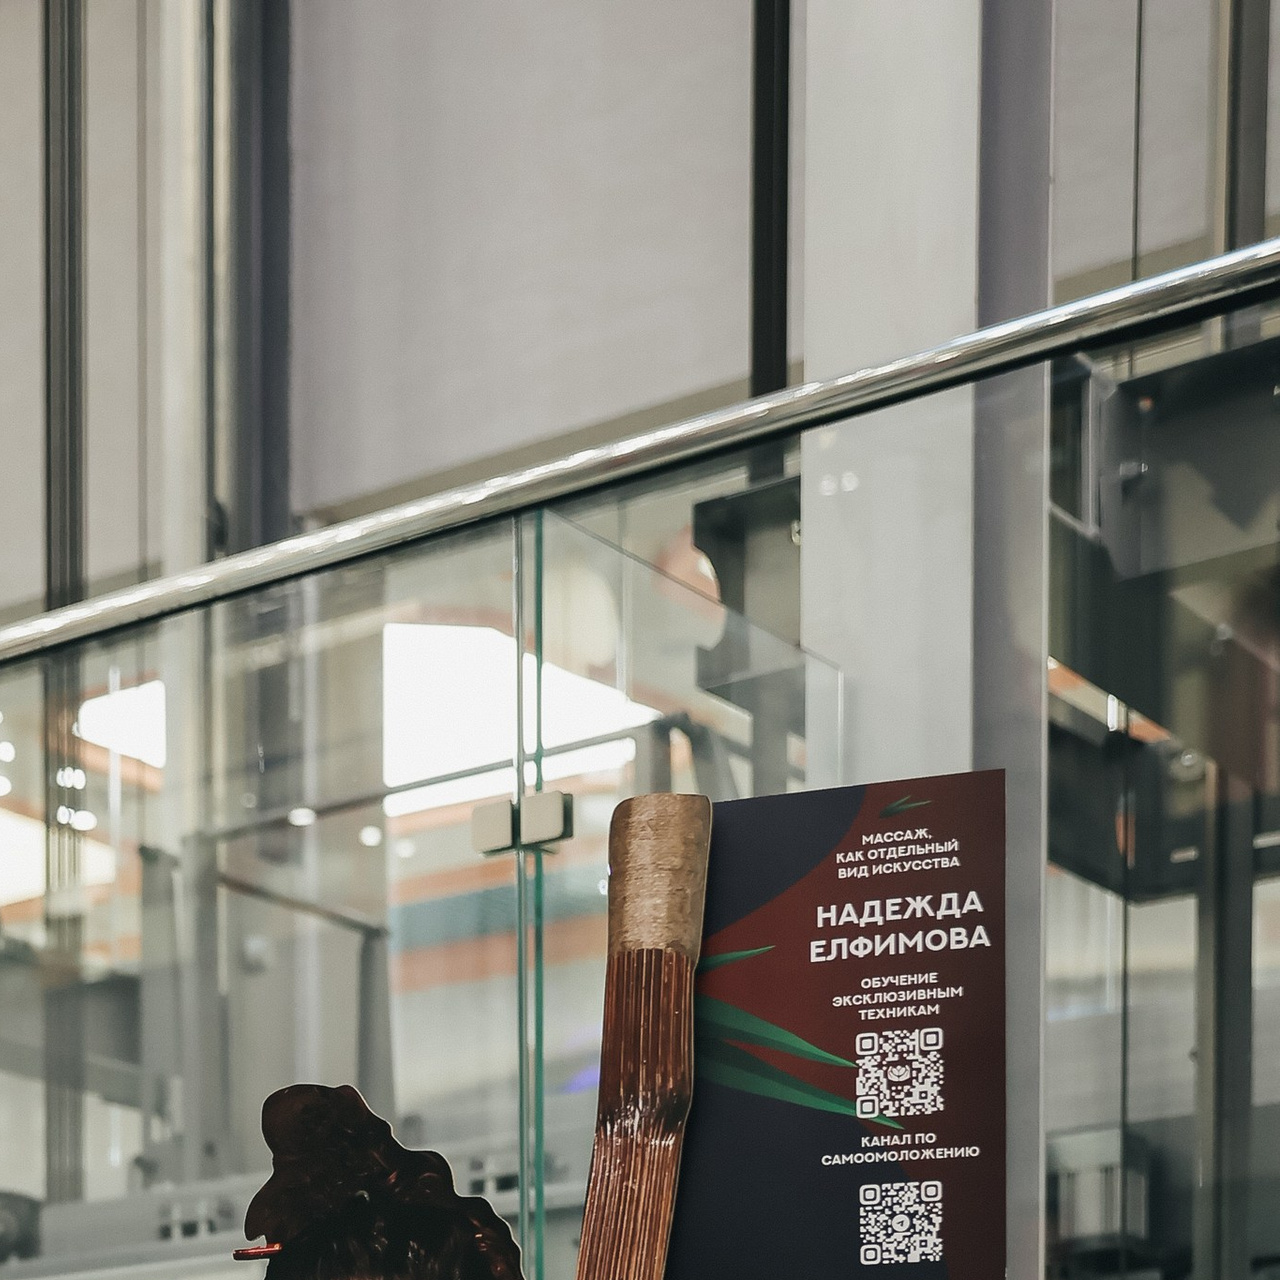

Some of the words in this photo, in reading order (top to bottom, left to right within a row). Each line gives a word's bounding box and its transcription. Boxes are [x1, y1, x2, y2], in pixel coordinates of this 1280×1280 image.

[862, 828, 932, 846] МАССАЖ,
[836, 850, 865, 864] КАК
[867, 839, 960, 860] ОТДЕЛЬНЫЙ
[838, 865, 869, 879] ВИД
[872, 856, 961, 876] ИСКУССТВА
[816, 890, 984, 928] НАДЕЖДА
[810, 925, 992, 963] ЕЛФИМОВА
[860, 972, 939, 989] ОБУЧЕНИЕ
[832, 986, 964, 1007] ЭКСКЛЮЗИВНЫМ
[858, 1004, 940, 1021] ТЕХНИКАМ
[861, 1134, 911, 1148] КАНАЛ
[915, 1132, 937, 1144] ПО
[821, 1146, 981, 1166] САМООМОЛОЖЕНИЮ
